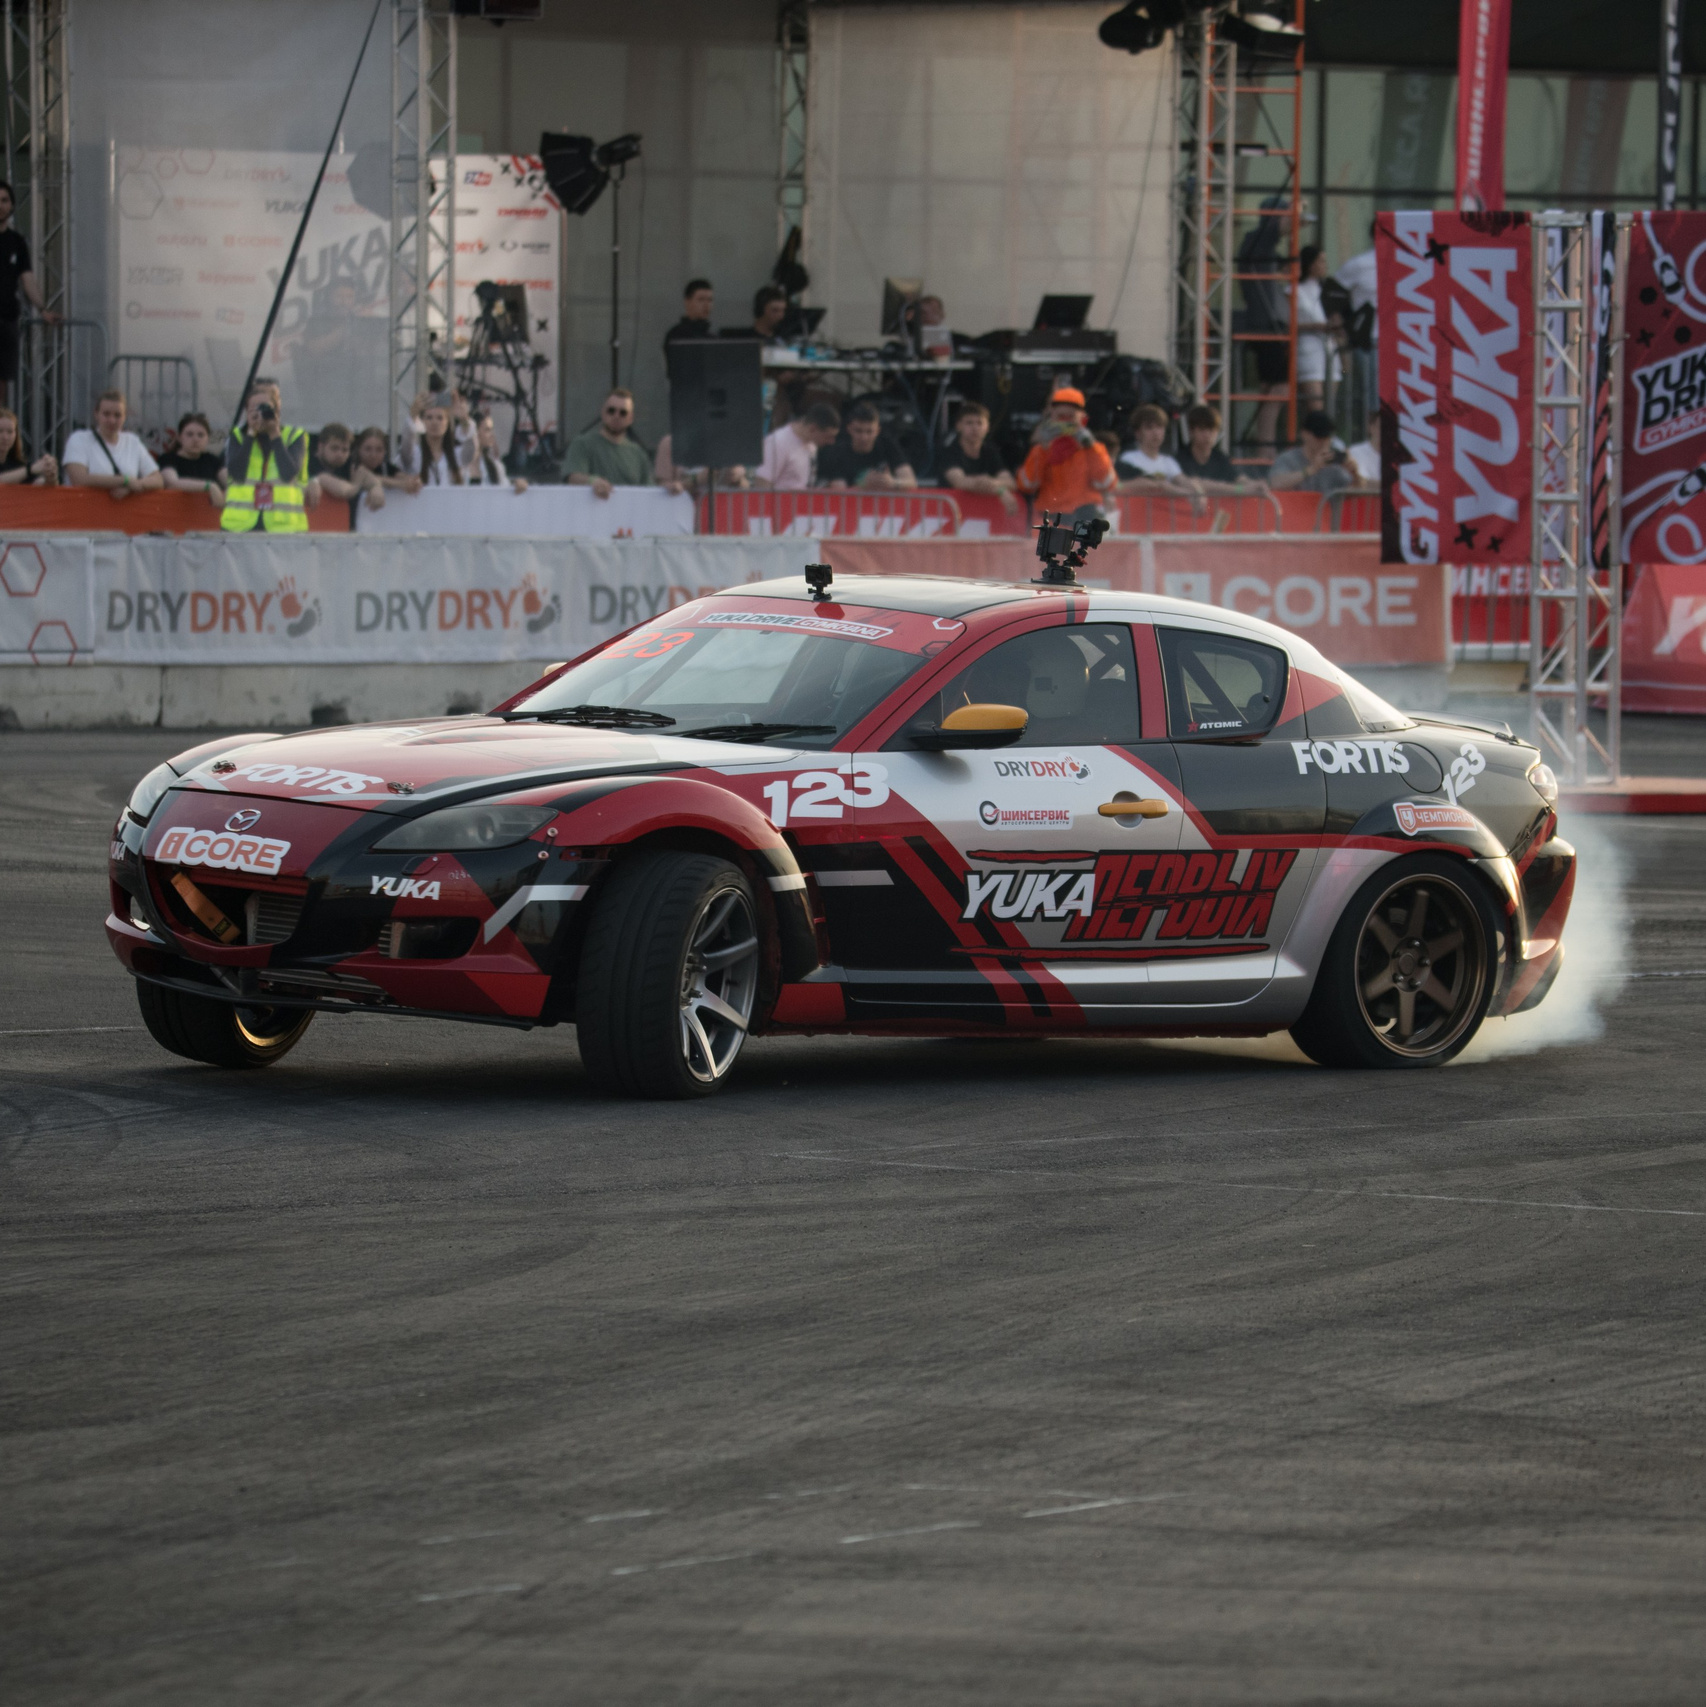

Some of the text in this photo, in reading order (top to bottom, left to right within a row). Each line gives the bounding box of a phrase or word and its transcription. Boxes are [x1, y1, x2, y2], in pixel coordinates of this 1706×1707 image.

[1394, 211, 1439, 564] GYMKHANA
[1449, 247, 1520, 523] YUKA
[106, 590, 272, 634] DRYDRY
[355, 589, 516, 634] DRYDRY
[1200, 721, 1242, 730] ATOMIC
[219, 763, 384, 795] FORTIS
[994, 761, 1068, 778] DRYDRY
[1291, 741, 1410, 775] FORTIS
[1442, 743, 1486, 806] 123
[763, 762, 890, 827] 123
[1001, 810, 1070, 821] ШИНСЕРВИС
[369, 875, 441, 901] YUKA
[962, 873, 1096, 919] YUKA
